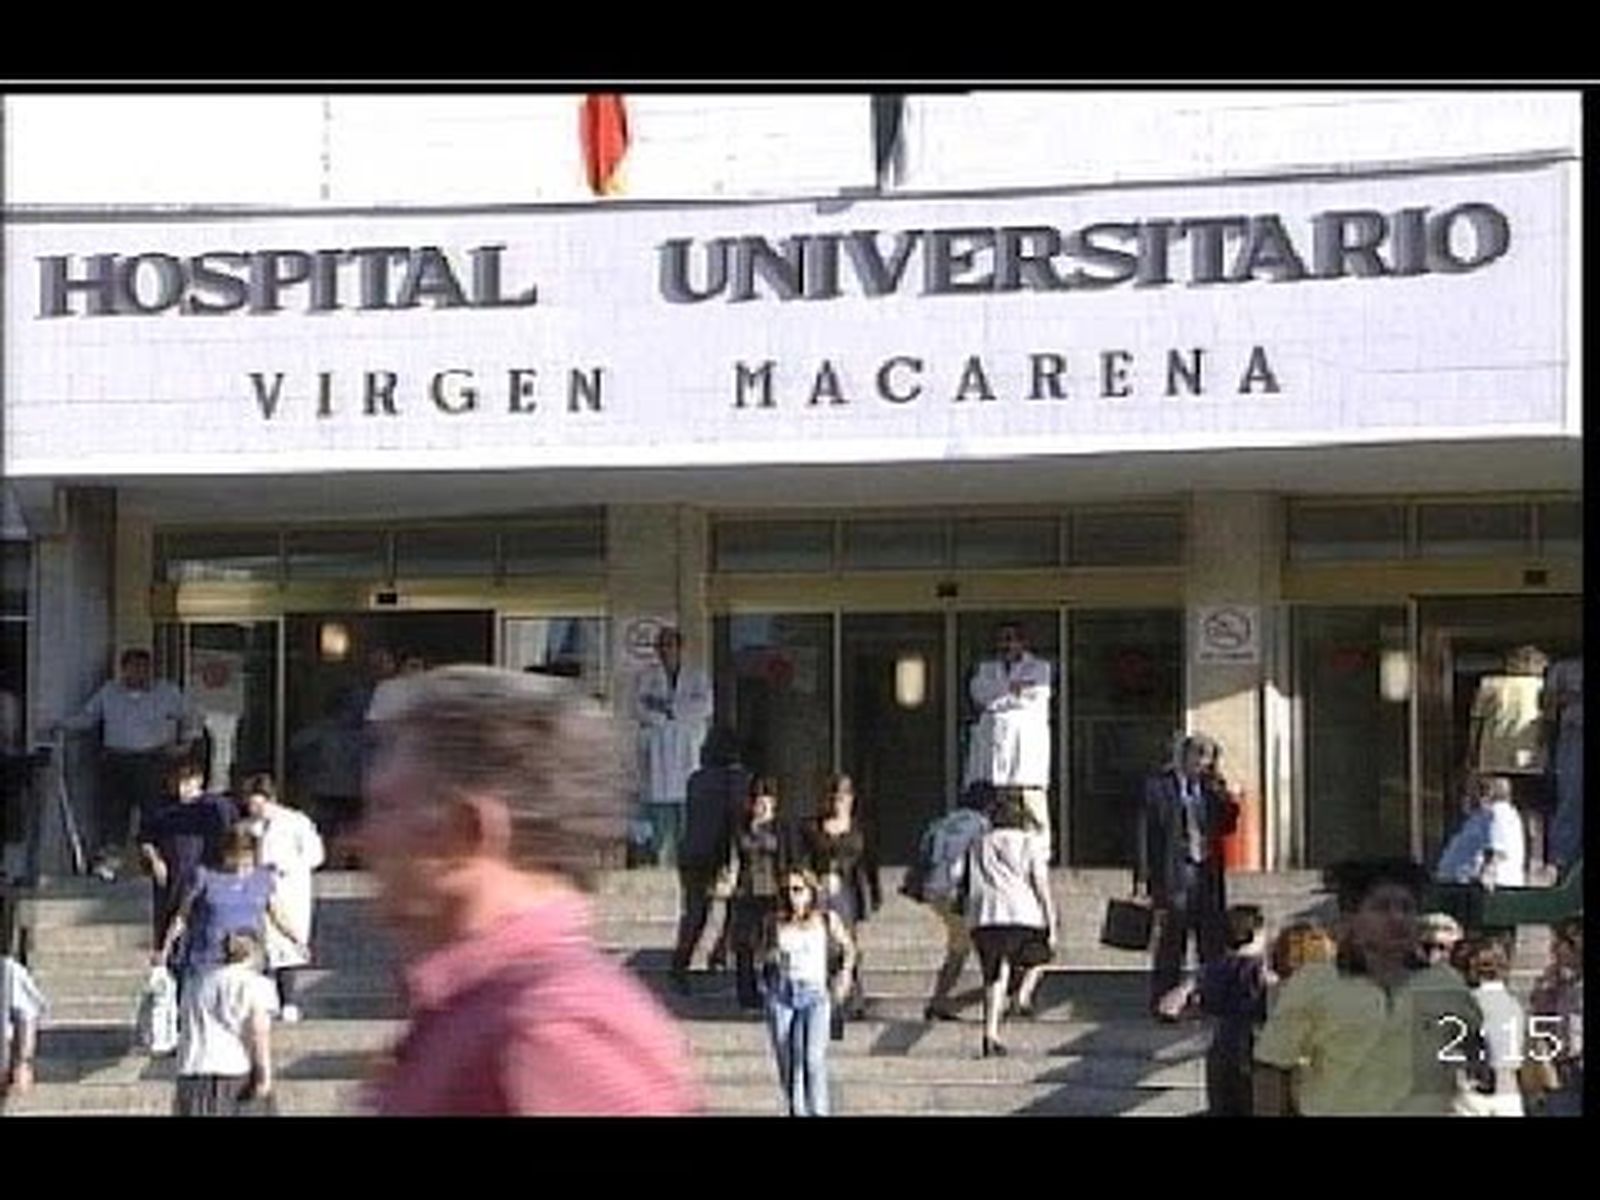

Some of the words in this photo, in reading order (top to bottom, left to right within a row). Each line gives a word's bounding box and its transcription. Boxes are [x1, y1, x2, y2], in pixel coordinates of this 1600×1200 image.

[35, 244, 537, 319] HOSPITAL
[655, 201, 1511, 304] UNIVERSITARIO
[250, 366, 607, 420] VIRGEN
[733, 345, 1281, 409] MACARENA
